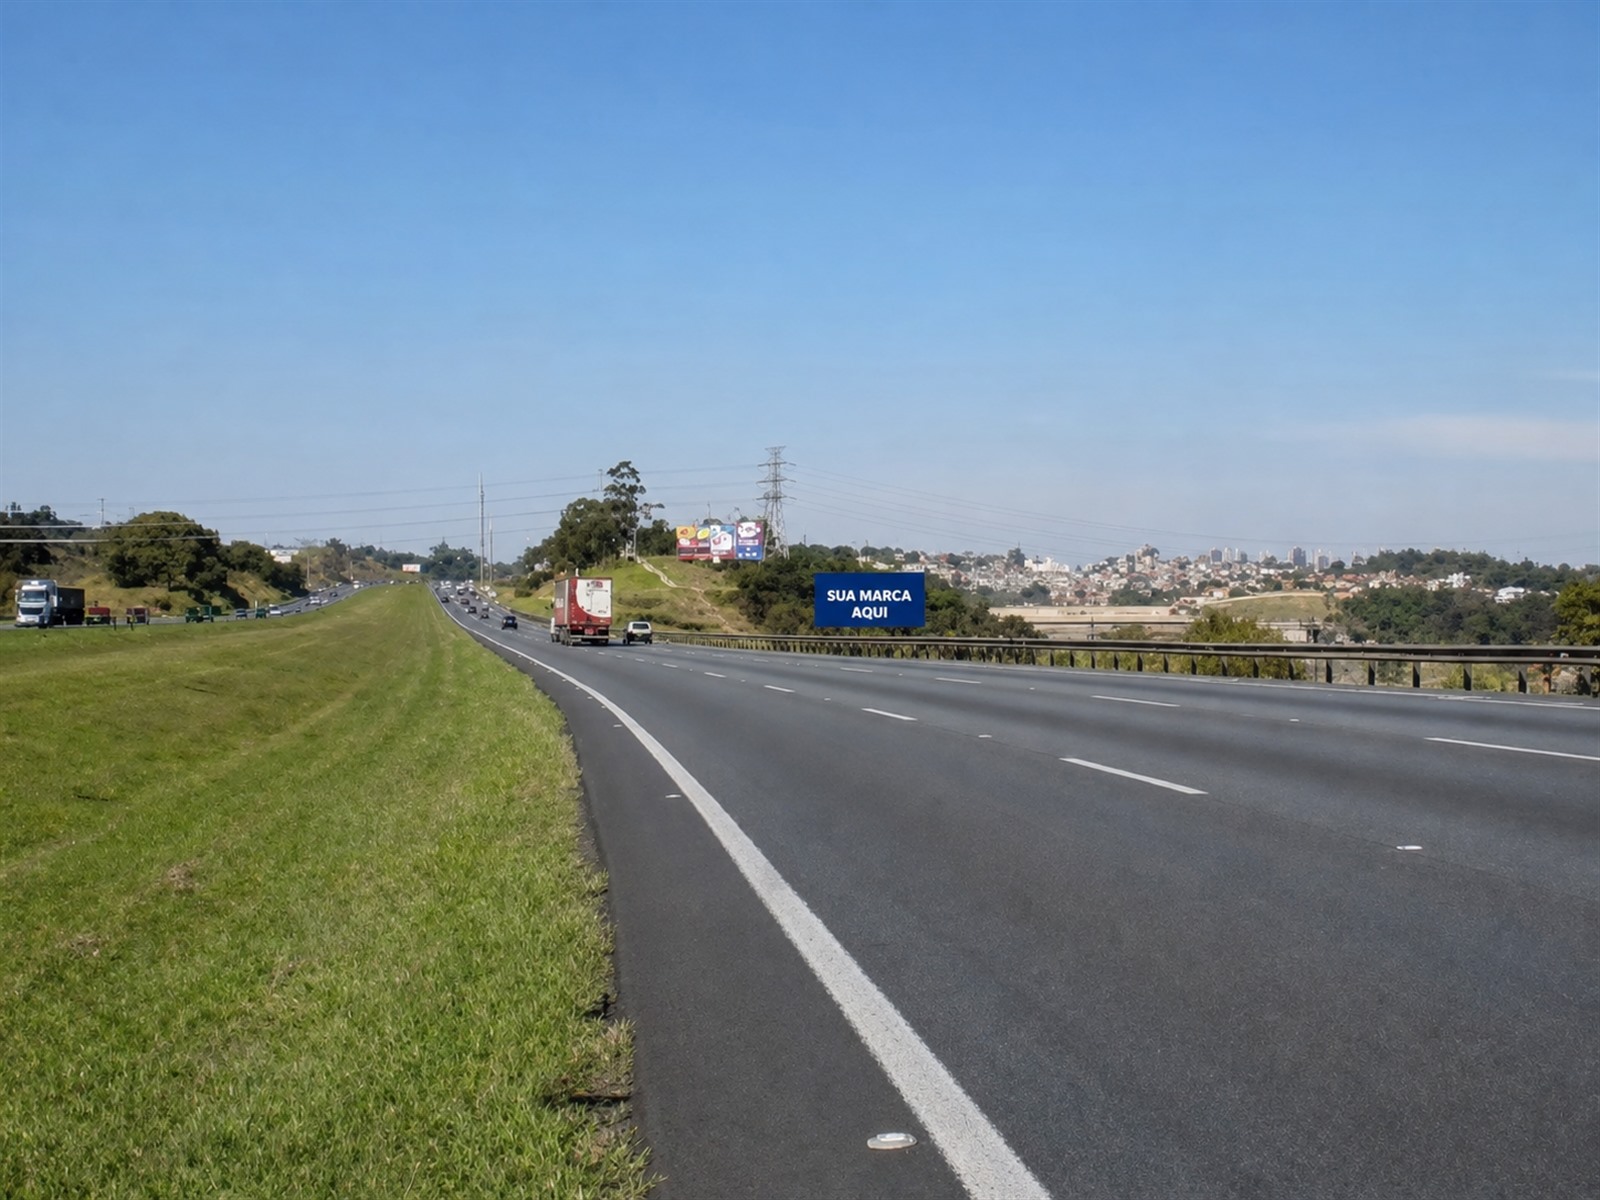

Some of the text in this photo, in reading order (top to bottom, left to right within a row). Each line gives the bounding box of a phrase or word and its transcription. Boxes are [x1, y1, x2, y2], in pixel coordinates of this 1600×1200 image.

[827, 589, 912, 602] SUA MARCA
[851, 606, 888, 619] AQUI
